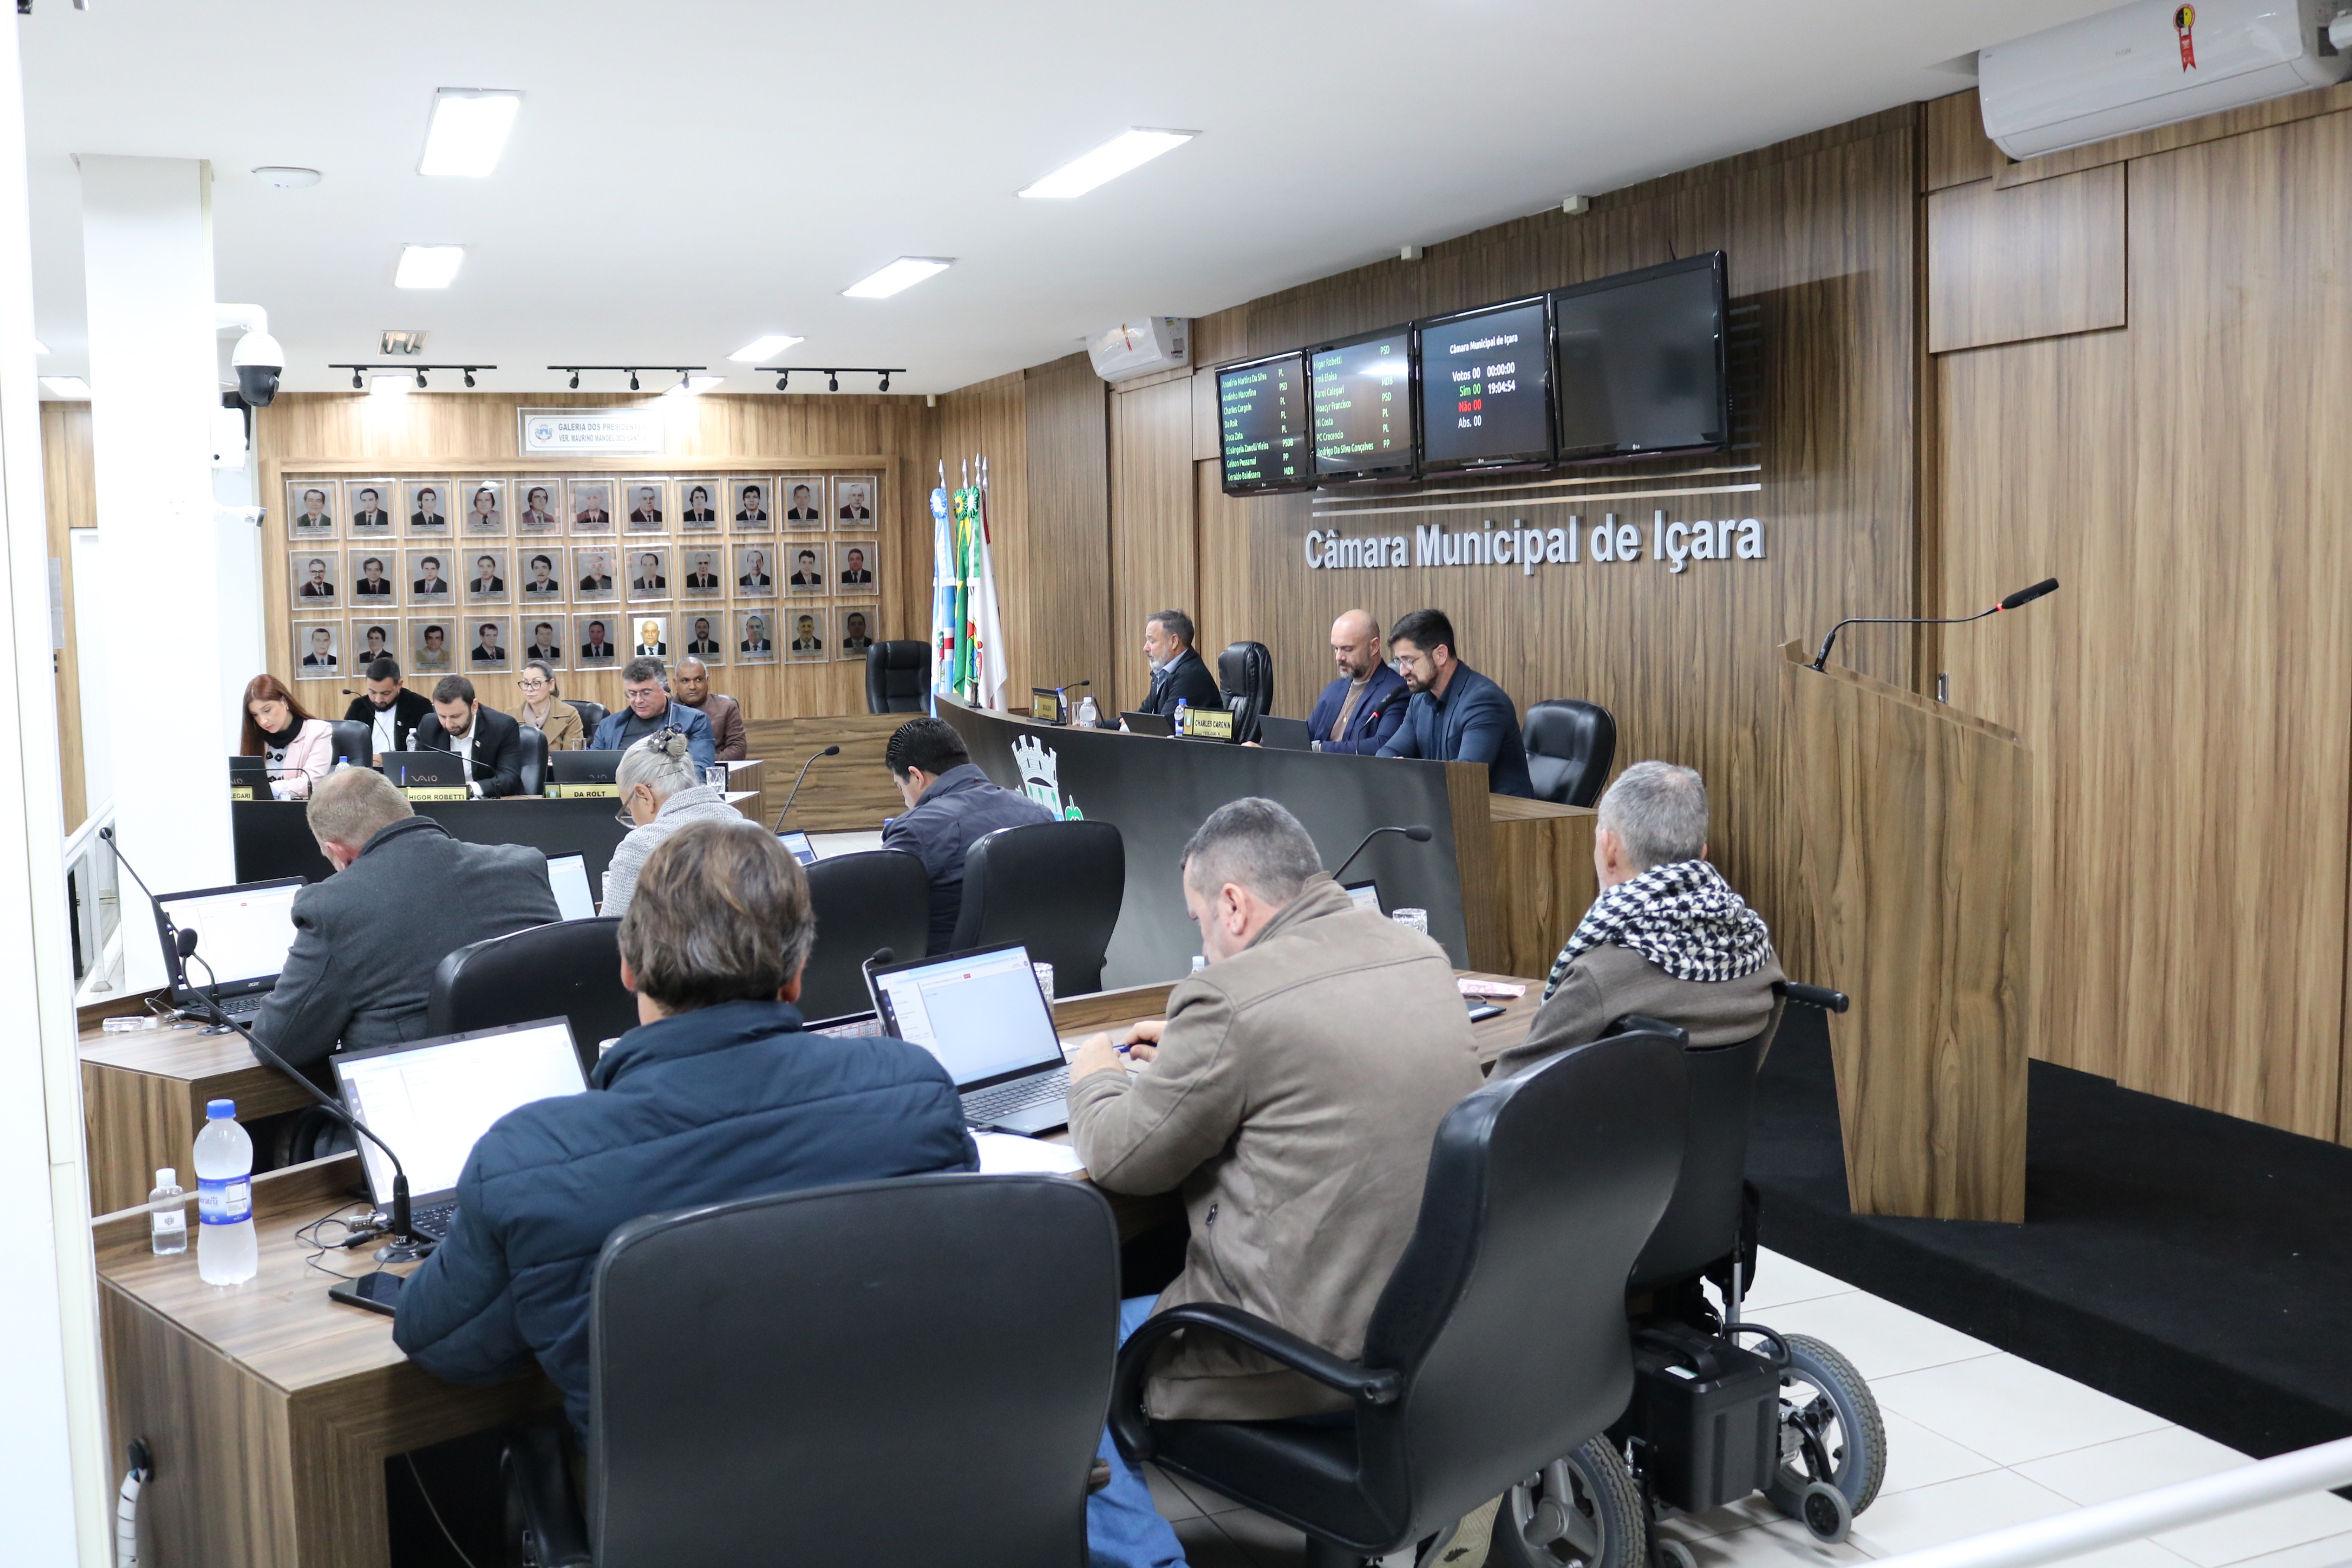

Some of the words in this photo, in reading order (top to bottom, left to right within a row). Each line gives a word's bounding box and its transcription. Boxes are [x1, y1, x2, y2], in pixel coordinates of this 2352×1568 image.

[1450, 344, 1469, 354] Câmara
[1470, 336, 1496, 350] Municipal
[1497, 335, 1504, 345] de
[1504, 334, 1518, 346] Içara
[1314, 360, 1325, 370] Higor
[1326, 355, 1342, 367] Robetti
[1380, 345, 1390, 355] PSD
[1238, 375, 1252, 386] Martins
[1252, 374, 1257, 383] Da
[1257, 373, 1267, 381] Silva
[1279, 368, 1284, 377] PL
[1452, 370, 1471, 382] Votos
[1472, 367, 1481, 379] 00
[1487, 362, 1515, 377] 00:00:00
[1223, 392, 1237, 401] Andinho
[1239, 388, 1256, 399] Marcelino
[1279, 382, 1288, 391] PSD
[1315, 387, 1326, 398] Karol
[1327, 384, 1344, 397] Calegari
[1381, 376, 1393, 387] MDB
[1459, 385, 1471, 397] Sim
[1473, 383, 1481, 394] 00
[1488, 380, 1515, 394] 19:04:54
[1224, 406, 1237, 415] Charles
[1237, 403, 1252, 413] Cargnin
[1280, 397, 1286, 405] PL
[1316, 404, 1331, 413] Moacyr
[1331, 399, 1351, 410] Francisco
[1382, 392, 1391, 402] PSD
[1459, 401, 1472, 412] Não
[1474, 399, 1482, 410] 00
[1281, 410, 1286, 419] PL
[1317, 419, 1321, 427] Ni
[1322, 417, 1334, 426] Costa
[1383, 408, 1389, 417] PL
[1458, 417, 1472, 429] Abs.
[1474, 415, 1482, 426] 00
[1234, 432, 1243, 440] Zata
[1282, 425, 1287, 433] PL
[1317, 433, 1322, 442] PC
[1323, 430, 1344, 441] Crecencio
[1383, 424, 1389, 433] PL
[1244, 443, 1257, 452] Zanolli
[1257, 442, 1269, 450] Vieira
[1283, 438, 1293, 447] PSDB
[1317, 446, 1333, 457] Rodrigo
[1334, 446, 1340, 455] Da
[1341, 444, 1351, 453] Silva
[1351, 442, 1374, 453] Gonçalves
[1383, 439, 1390, 449] PP
[1227, 459, 1239, 468] Gelson
[1240, 456, 1256, 466] Possamai
[1283, 453, 1289, 461] PP
[1228, 472, 1242, 481] Geraldo
[1242, 471, 1261, 480] Baldissera
[1284, 466, 1293, 475] MDB
[1305, 529, 1410, 569] Câmara
[1416, 515, 1580, 576] Municipal
[1591, 513, 1642, 562] de
[1654, 510, 1766, 573] Içara
